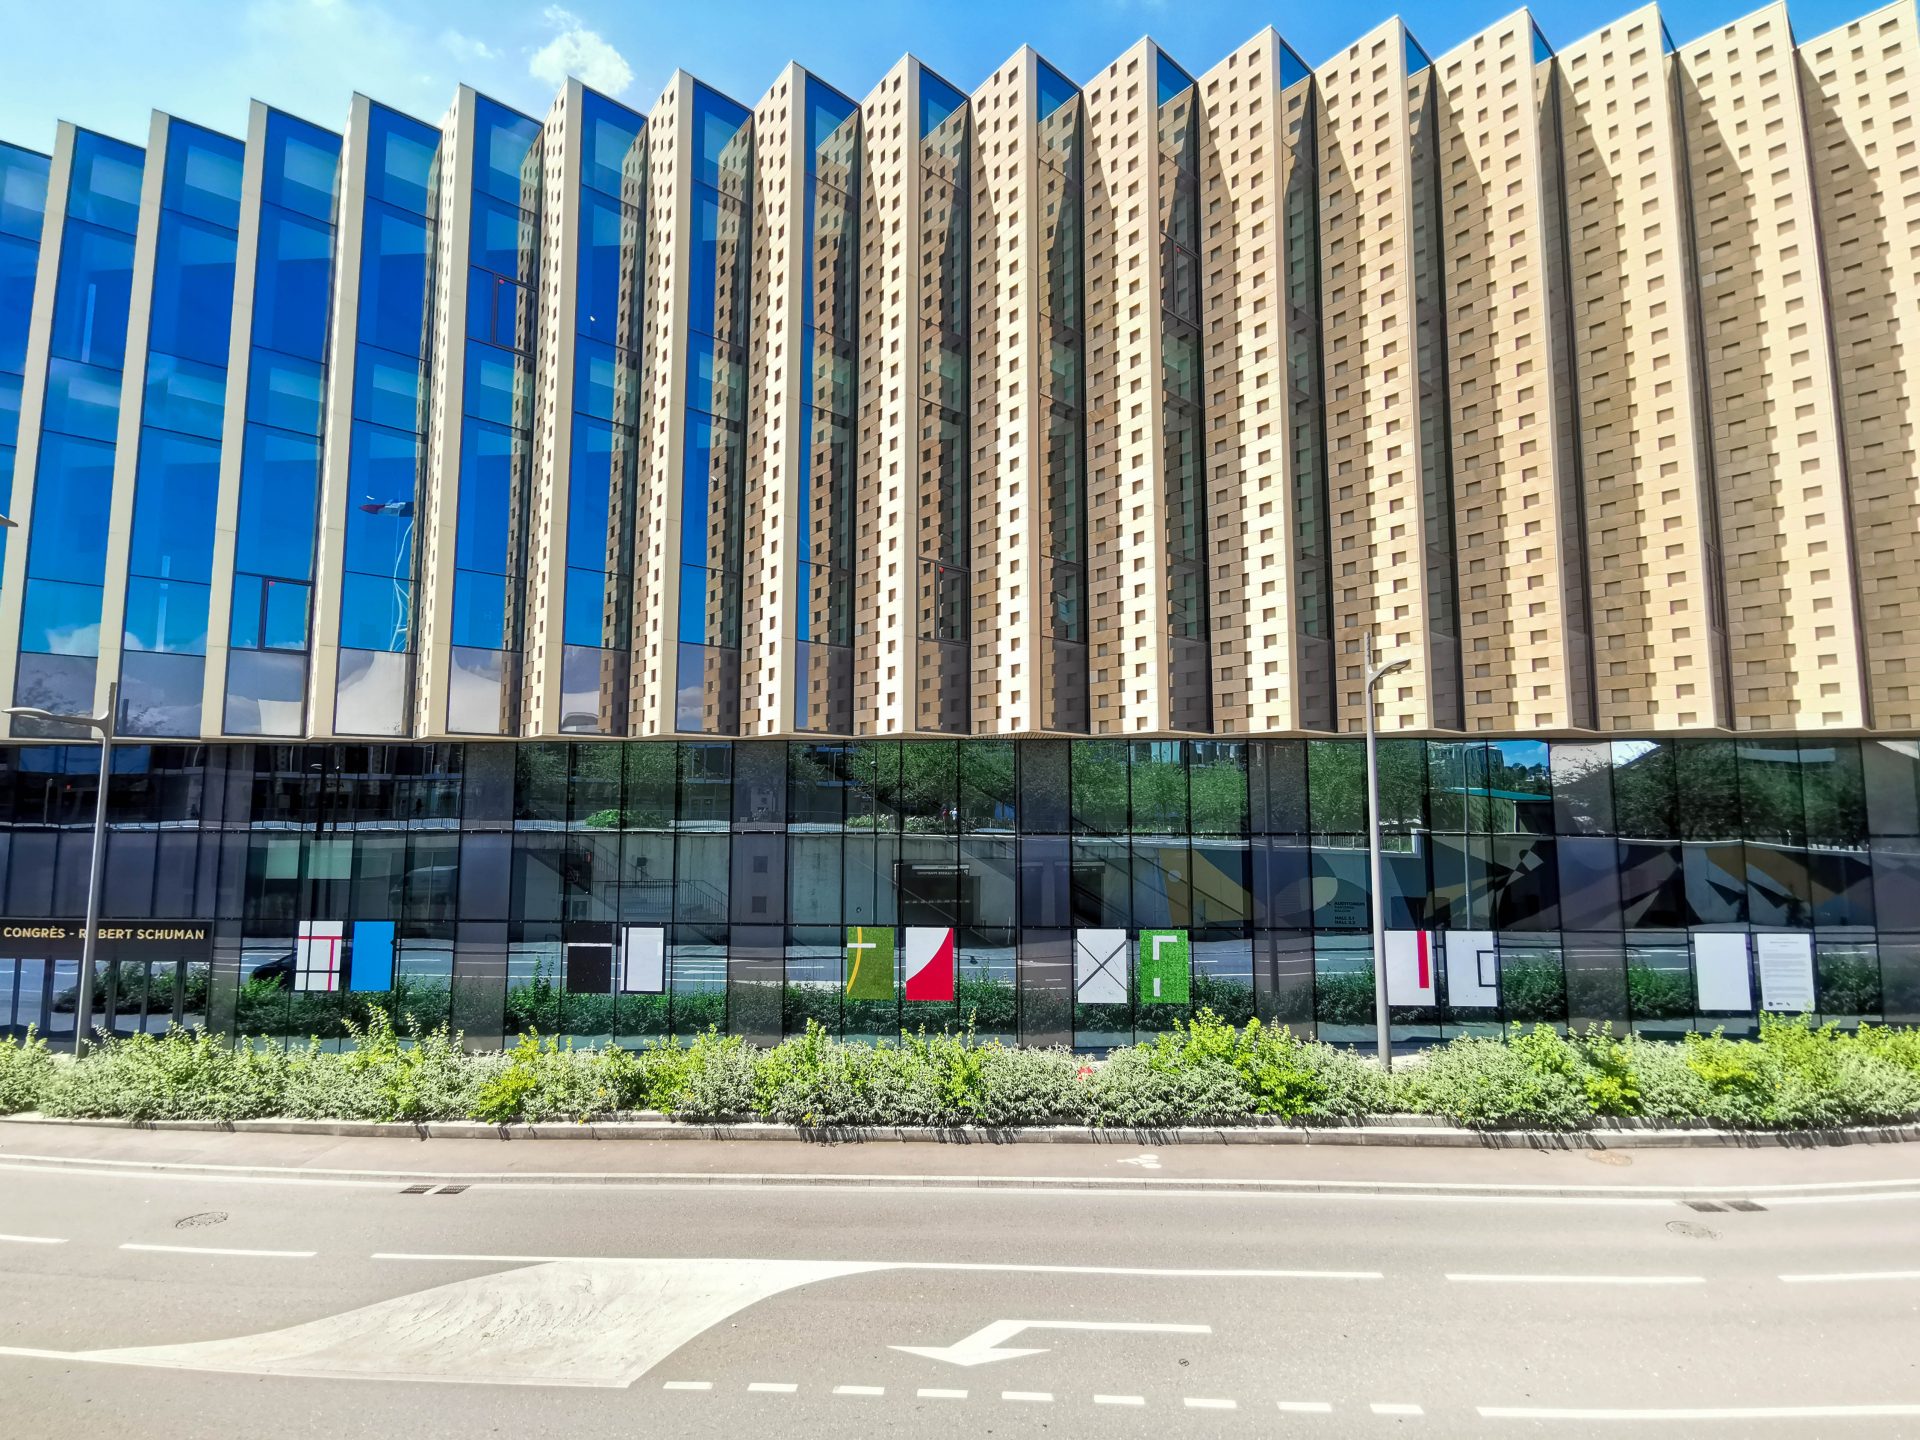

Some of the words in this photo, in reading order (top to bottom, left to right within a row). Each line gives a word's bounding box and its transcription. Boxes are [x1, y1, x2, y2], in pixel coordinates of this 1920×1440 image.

[3, 925, 66, 939] CONGRÈS
[78, 928, 133, 940] RBERT
[136, 929, 205, 940] SCHUMAN
